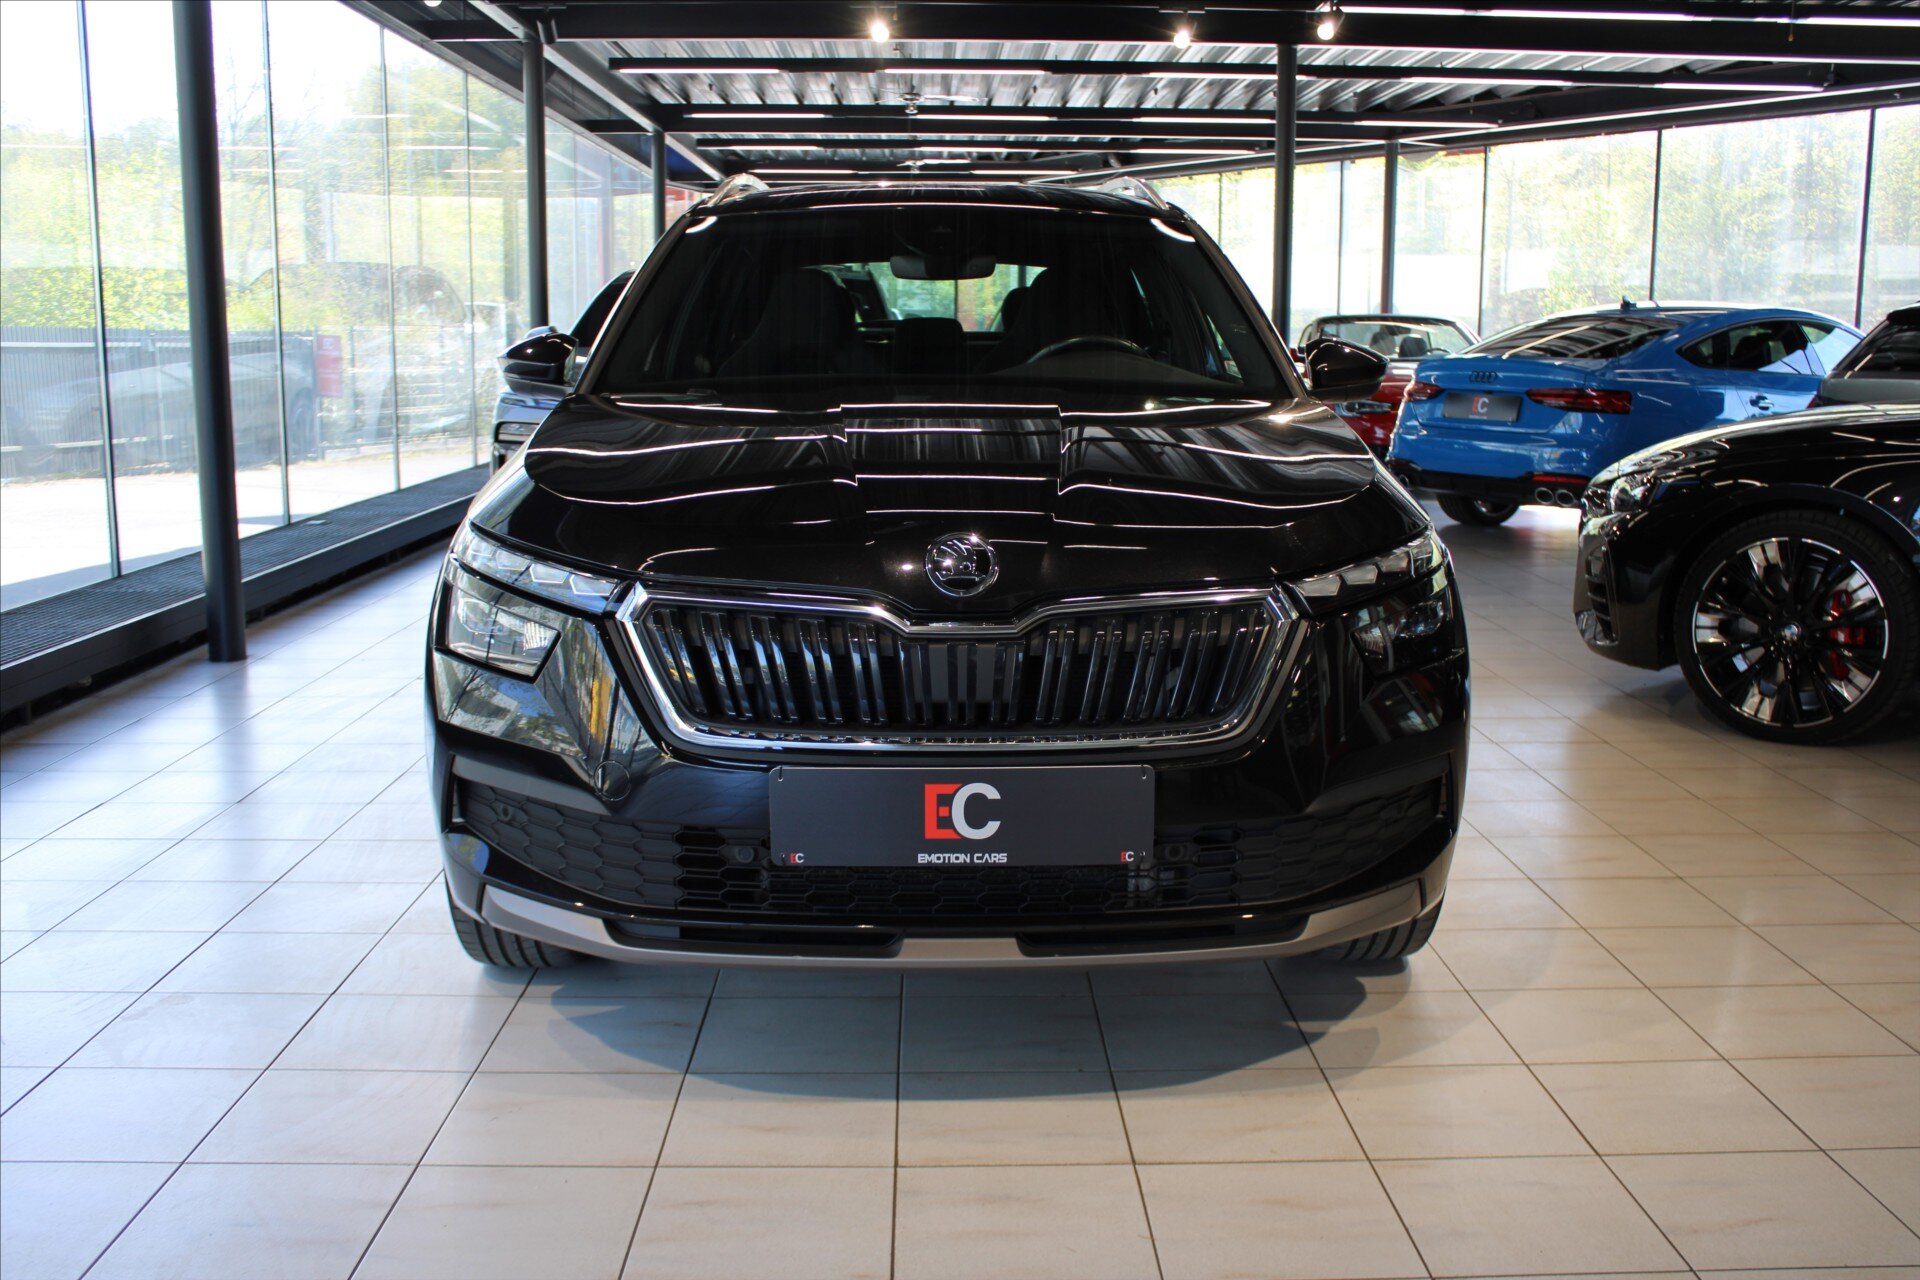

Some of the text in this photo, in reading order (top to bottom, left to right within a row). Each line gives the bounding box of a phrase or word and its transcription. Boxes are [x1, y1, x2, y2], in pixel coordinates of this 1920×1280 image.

[924, 782, 1002, 840] EC
[917, 853, 1008, 864] EMOTION CARS
